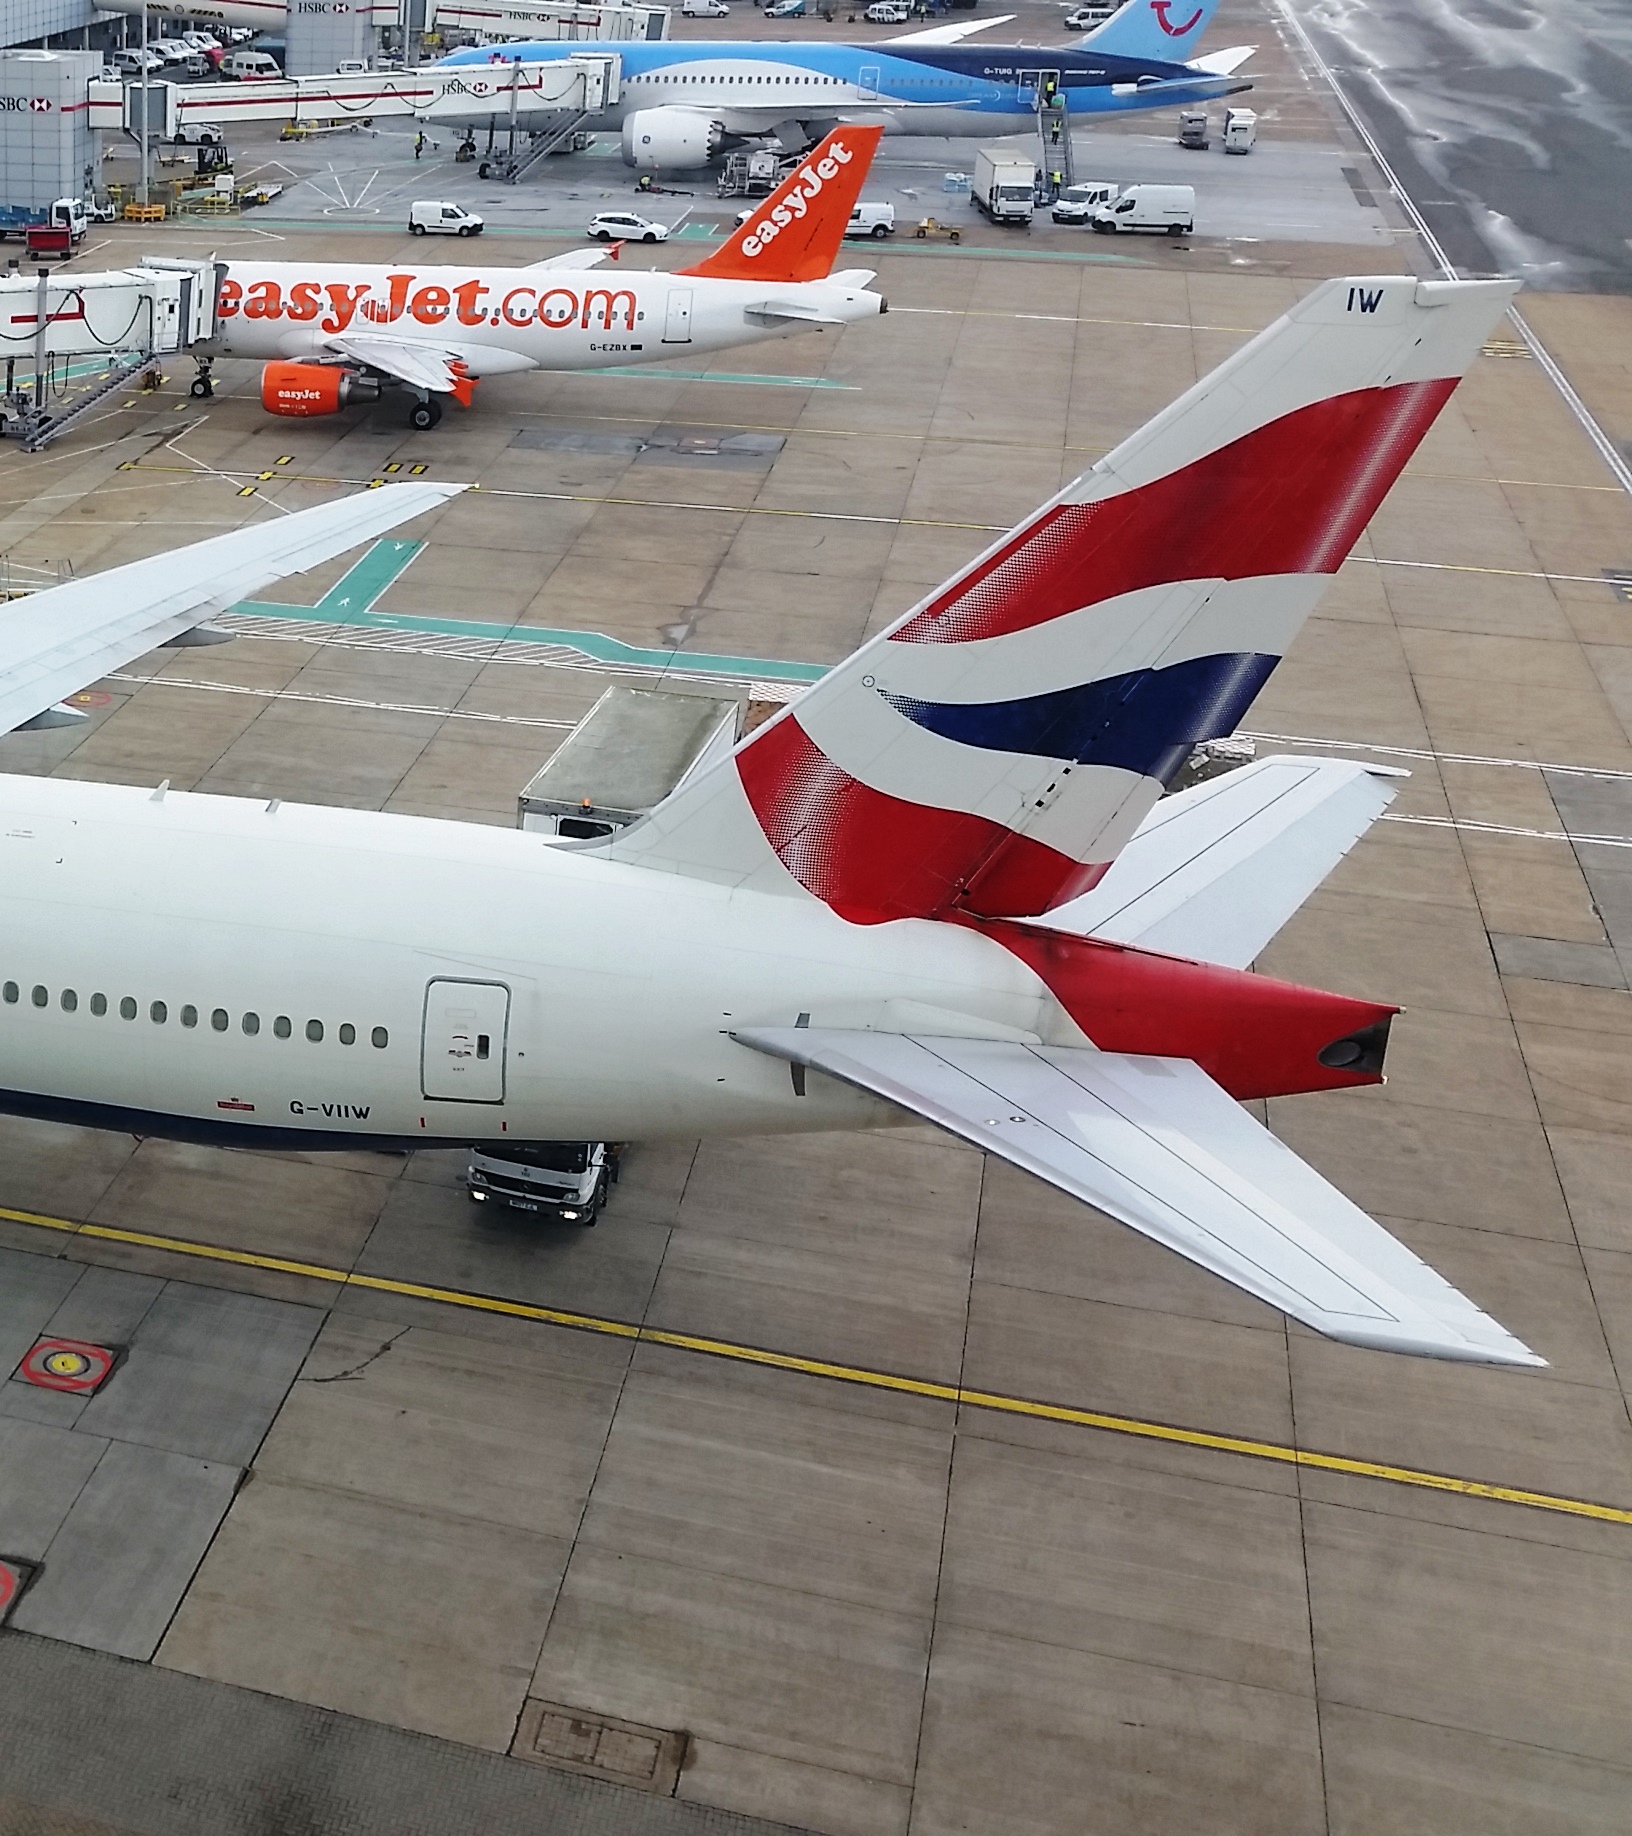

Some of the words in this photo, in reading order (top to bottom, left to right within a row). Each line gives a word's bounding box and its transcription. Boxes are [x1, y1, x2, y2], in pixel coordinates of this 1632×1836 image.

[298, 2, 330, 14] HSBC
[442, 82, 472, 95] HSBC
[741, 141, 853, 257] easyJet
[1346, 287, 1384, 313] IW
[278, 389, 321, 401] easyJet
[289, 1100, 371, 1120] G-VIIW
